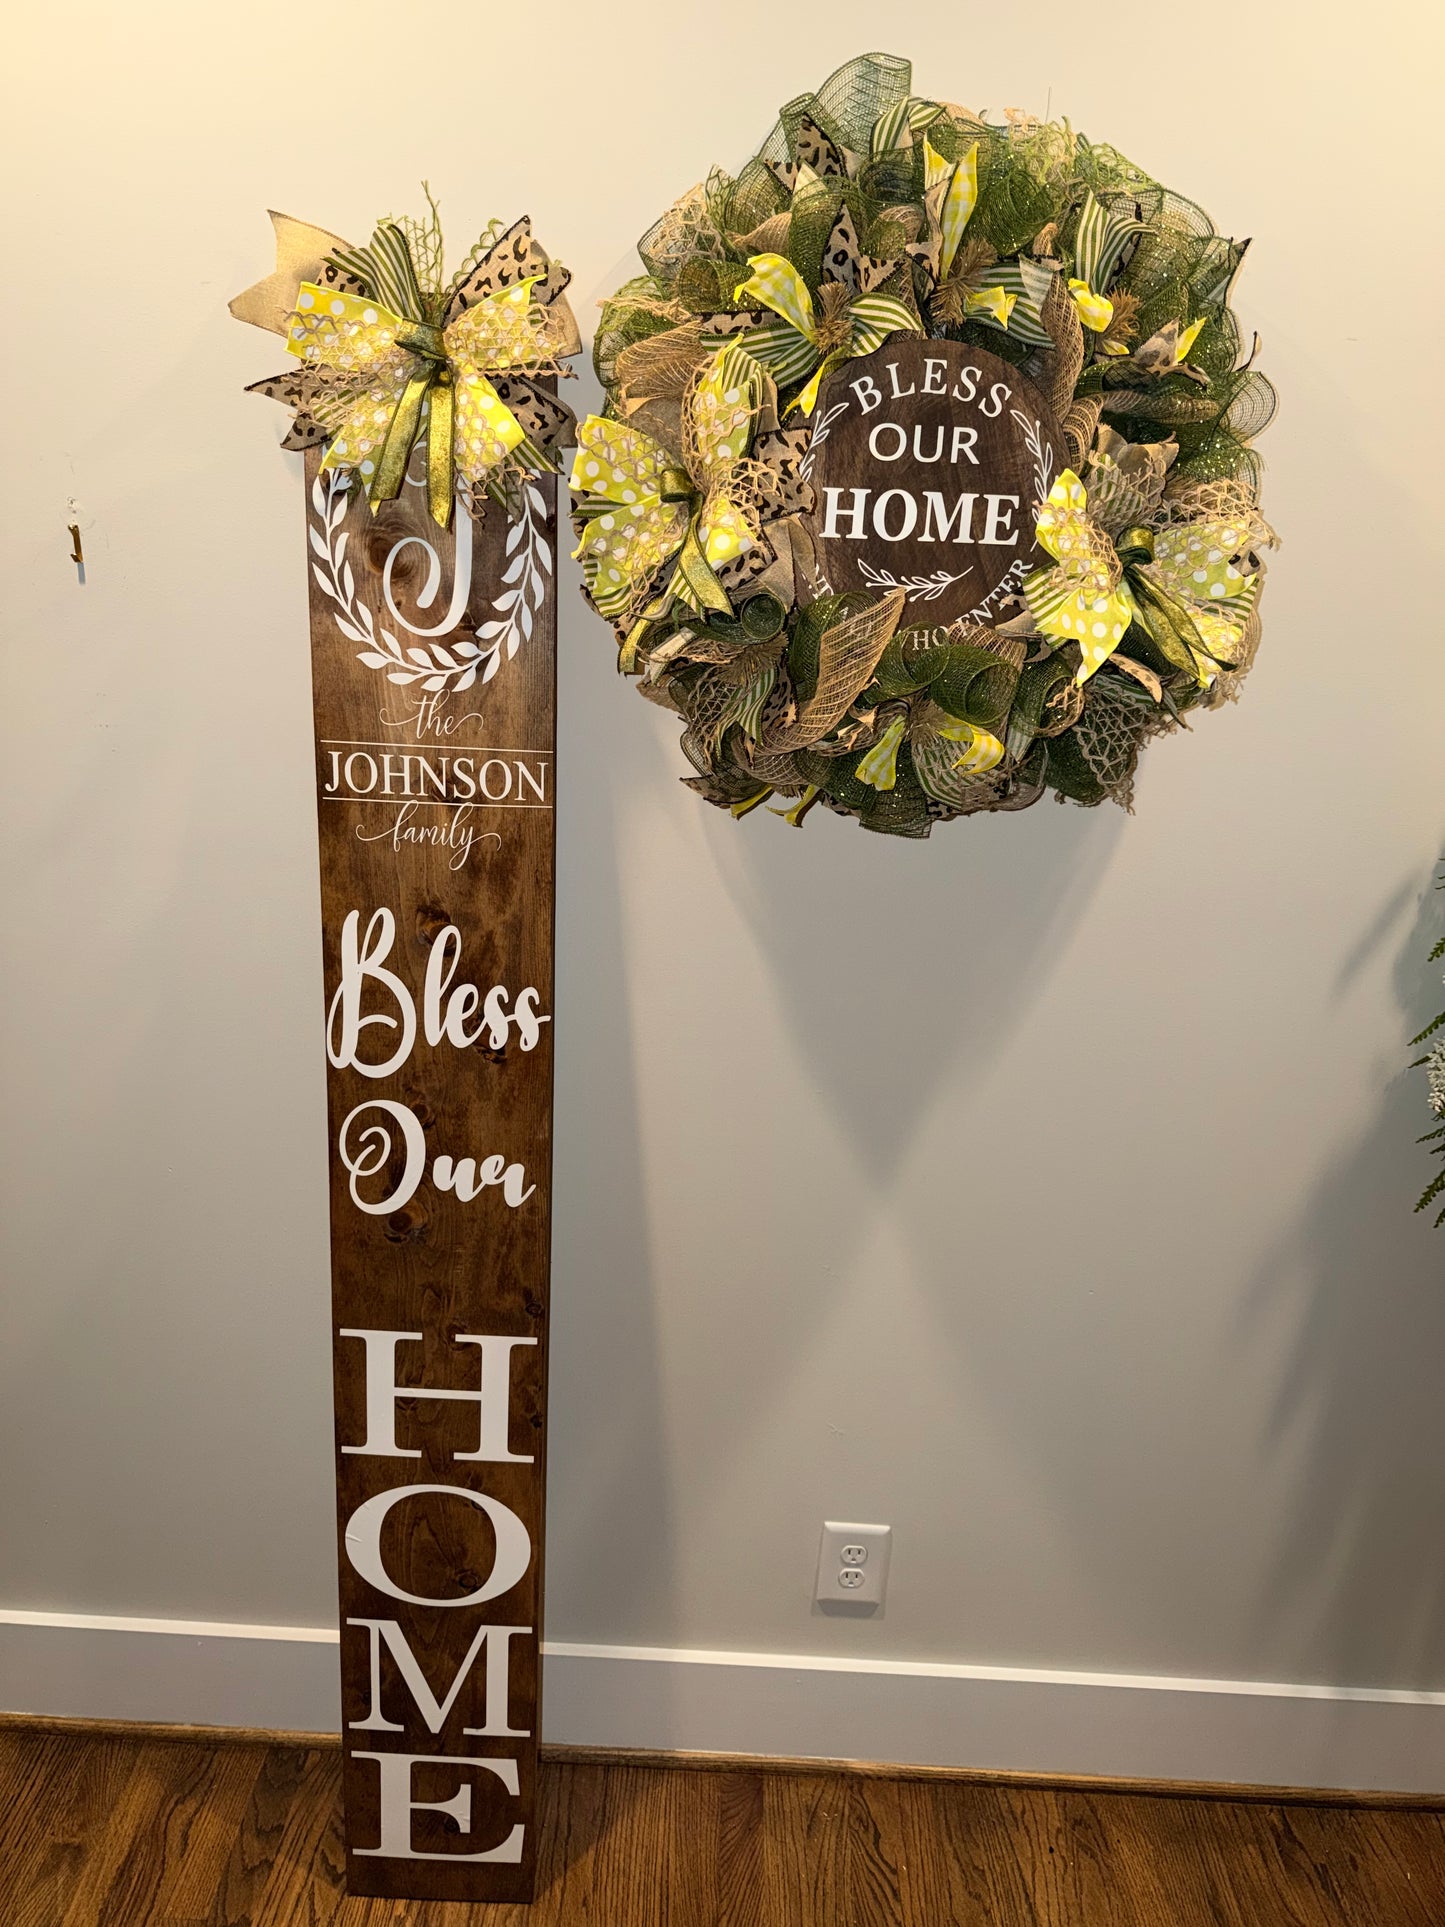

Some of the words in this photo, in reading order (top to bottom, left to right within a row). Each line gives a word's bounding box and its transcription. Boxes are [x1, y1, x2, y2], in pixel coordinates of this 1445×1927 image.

[850, 358, 1012, 417] BLESS
[869, 423, 980, 464] OUR
[819, 487, 1020, 545] HOME
[379, 689, 484, 738] the
[325, 751, 548, 801] JOHNSON
[355, 800, 502, 871] family
[327, 907, 551, 1078] Bless
[339, 1100, 536, 1215] Our
[339, 1328, 538, 1863] HOME
